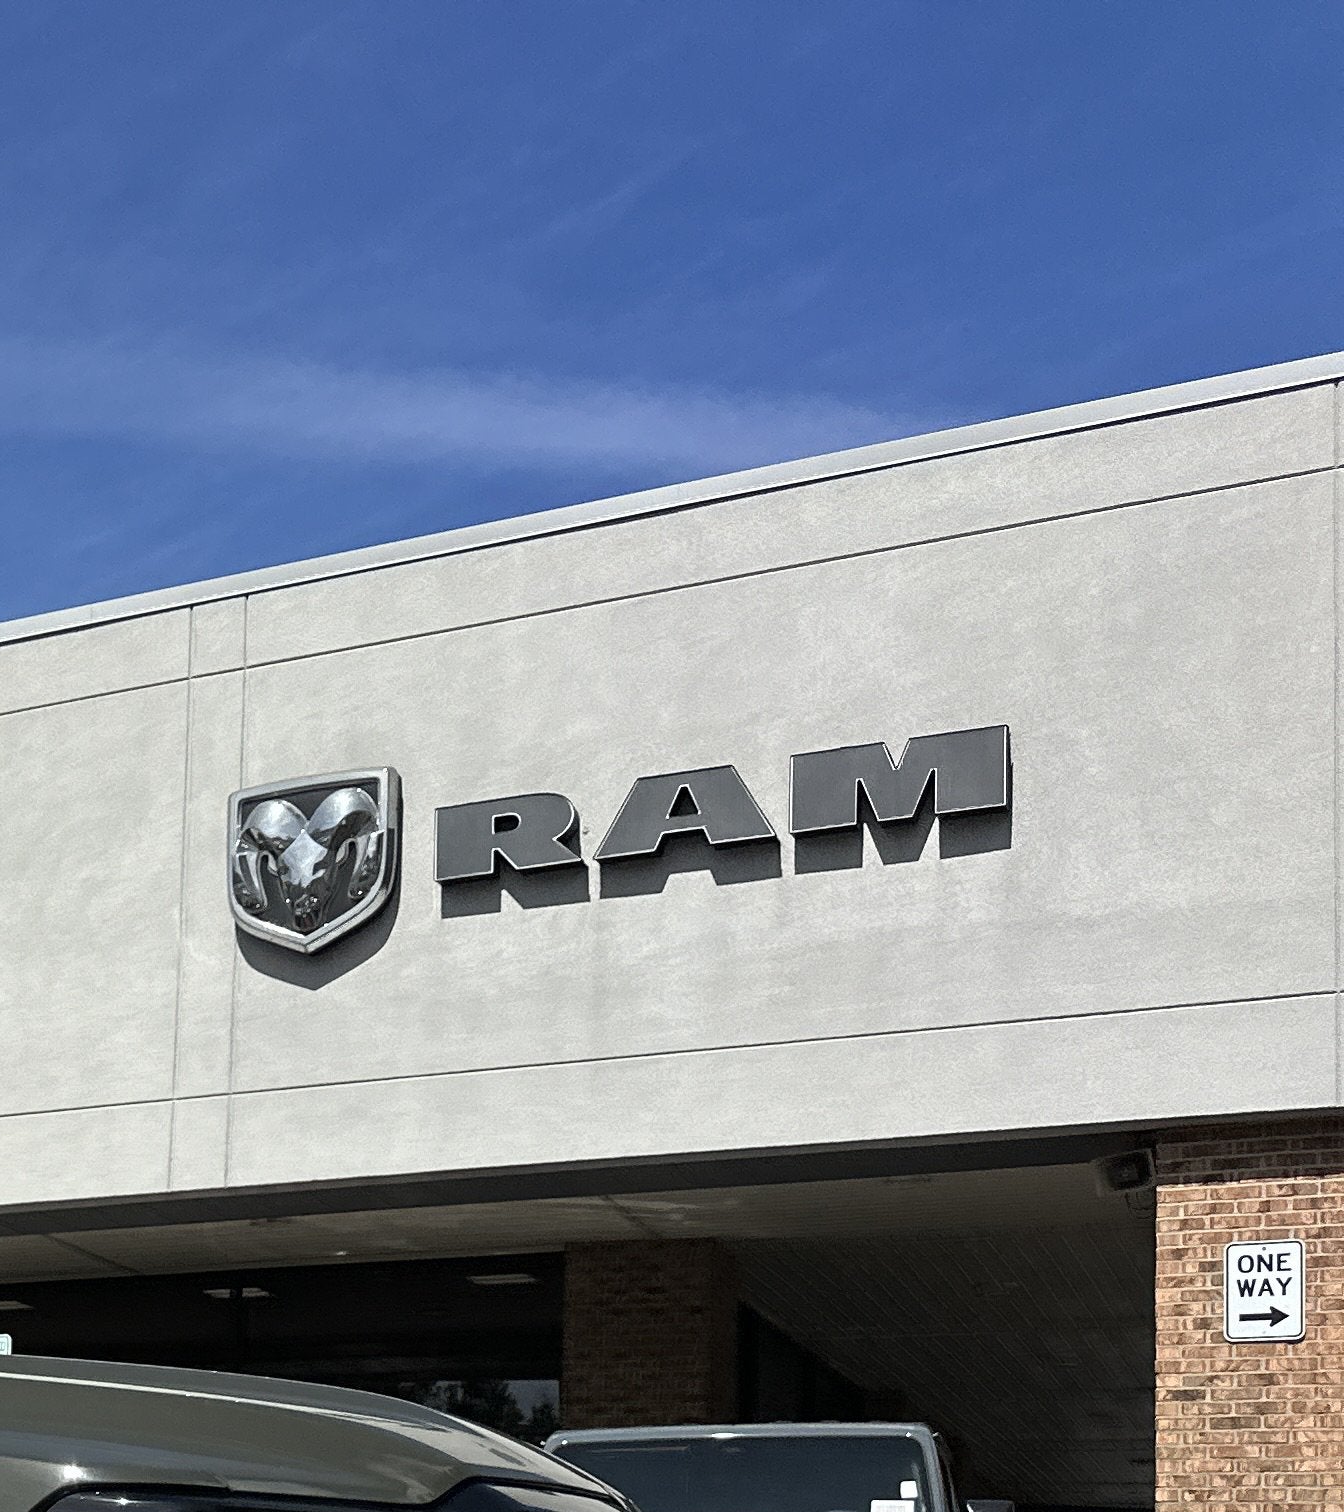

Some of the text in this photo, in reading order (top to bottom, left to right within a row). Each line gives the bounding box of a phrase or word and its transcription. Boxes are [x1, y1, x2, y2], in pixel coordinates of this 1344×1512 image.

[433, 724, 1012, 884] RAM
[1237, 1253, 1292, 1273] ONE
[1237, 1277, 1293, 1298] WAY
